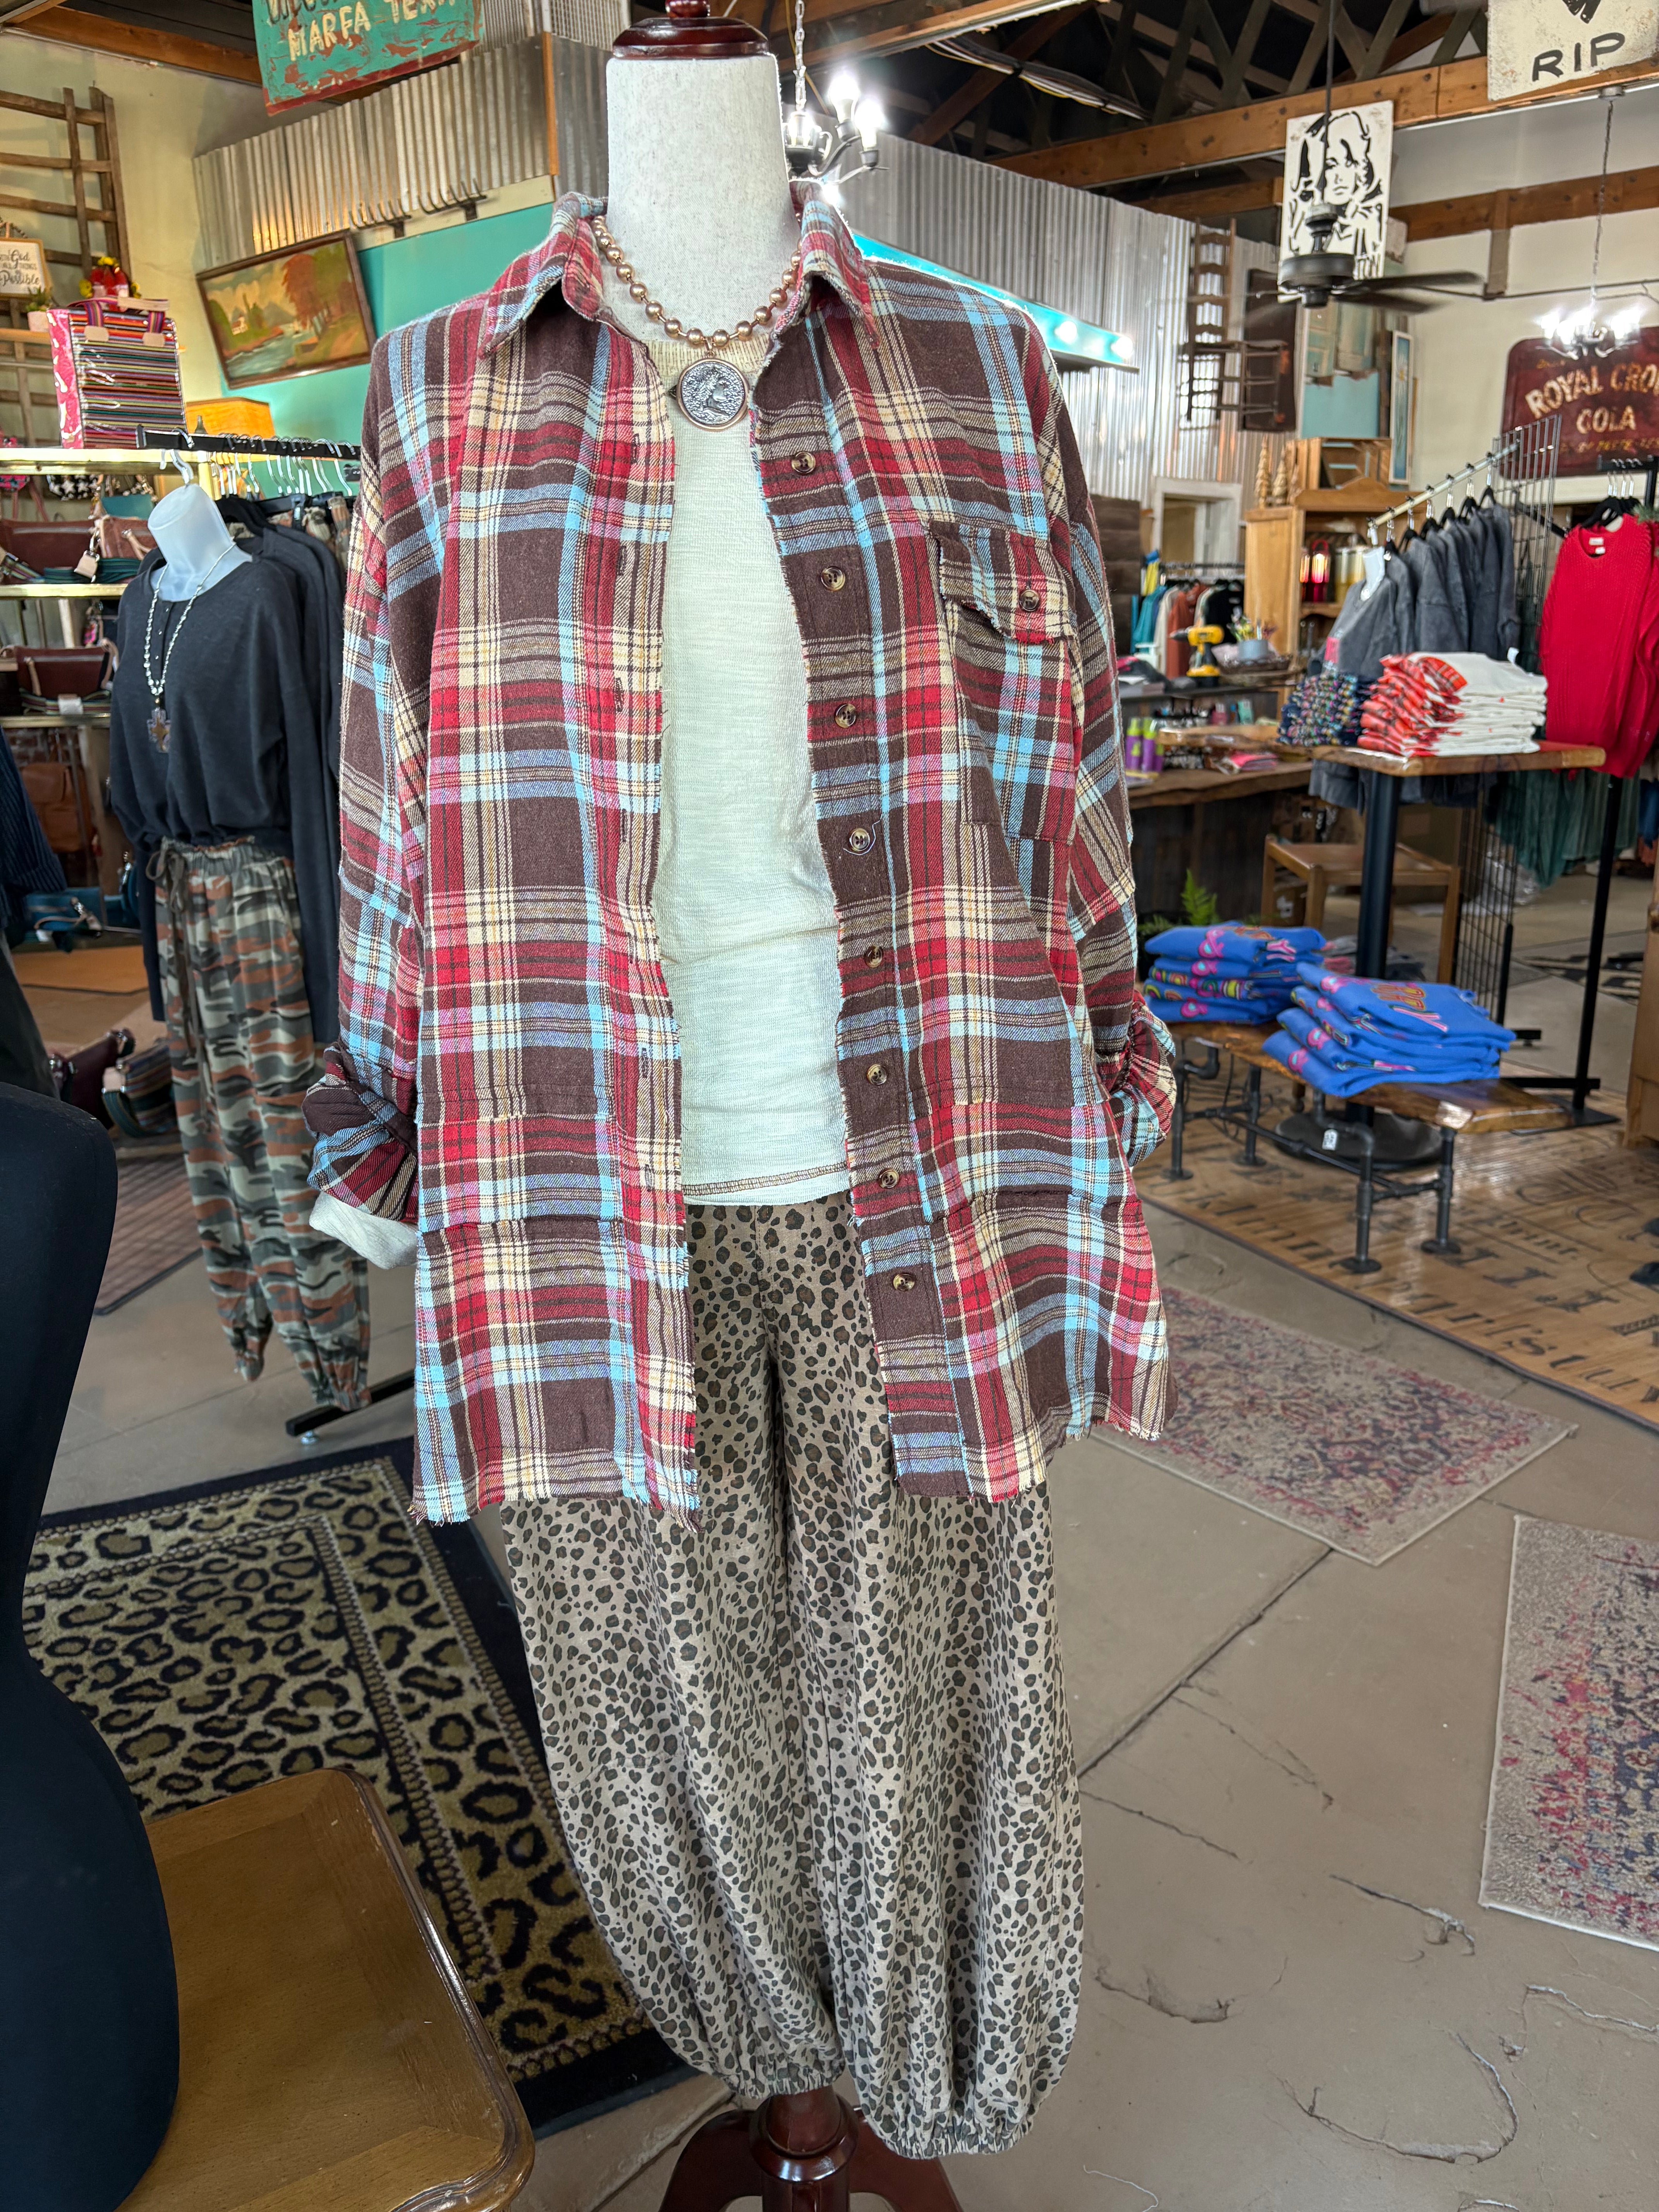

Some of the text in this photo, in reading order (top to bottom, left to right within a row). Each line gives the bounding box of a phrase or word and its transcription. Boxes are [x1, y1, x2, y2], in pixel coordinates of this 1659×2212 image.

[288, 1, 371, 61] MARFA
[1532, 32, 1625, 82] RIP
[1525, 365, 1604, 419] ROYAL
[1576, 405, 1636, 433] COLA
